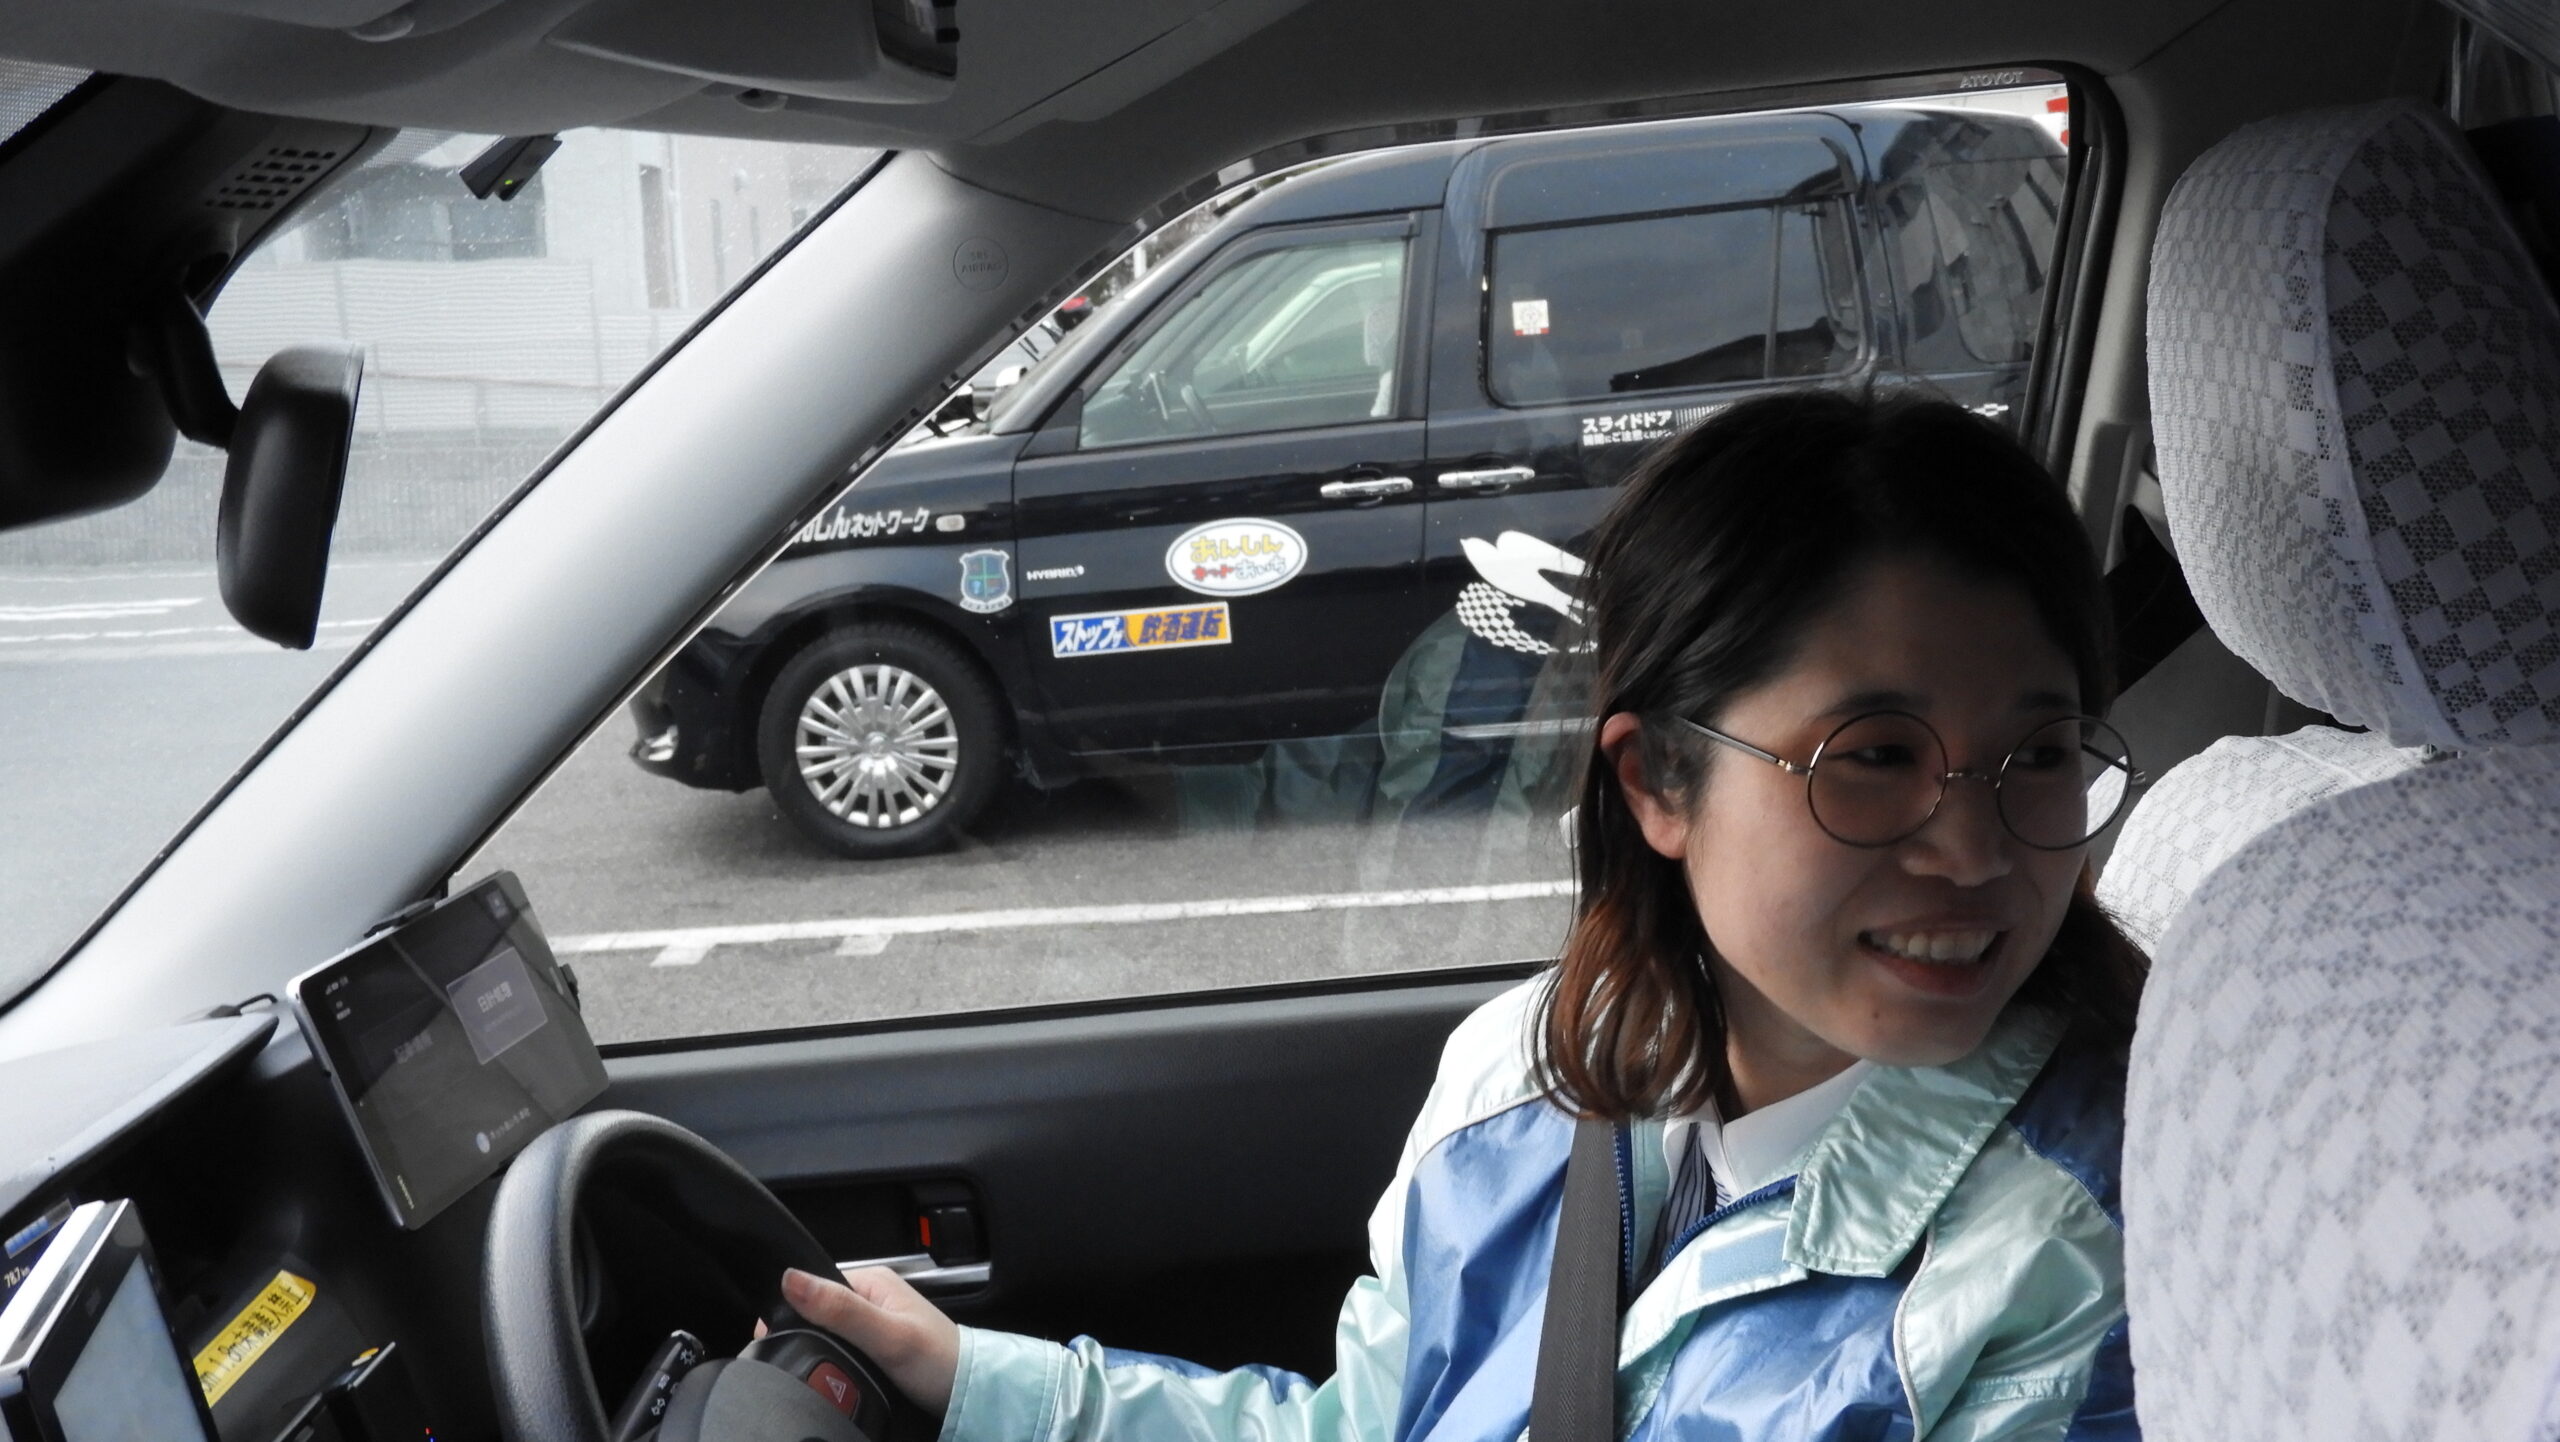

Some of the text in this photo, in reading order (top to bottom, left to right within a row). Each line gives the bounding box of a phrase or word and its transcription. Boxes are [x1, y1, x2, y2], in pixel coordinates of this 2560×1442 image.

[1582, 410, 1673, 434] スライドドア
[1190, 533, 1284, 563] あんしん
[1026, 566, 1078, 581] HYBRID
